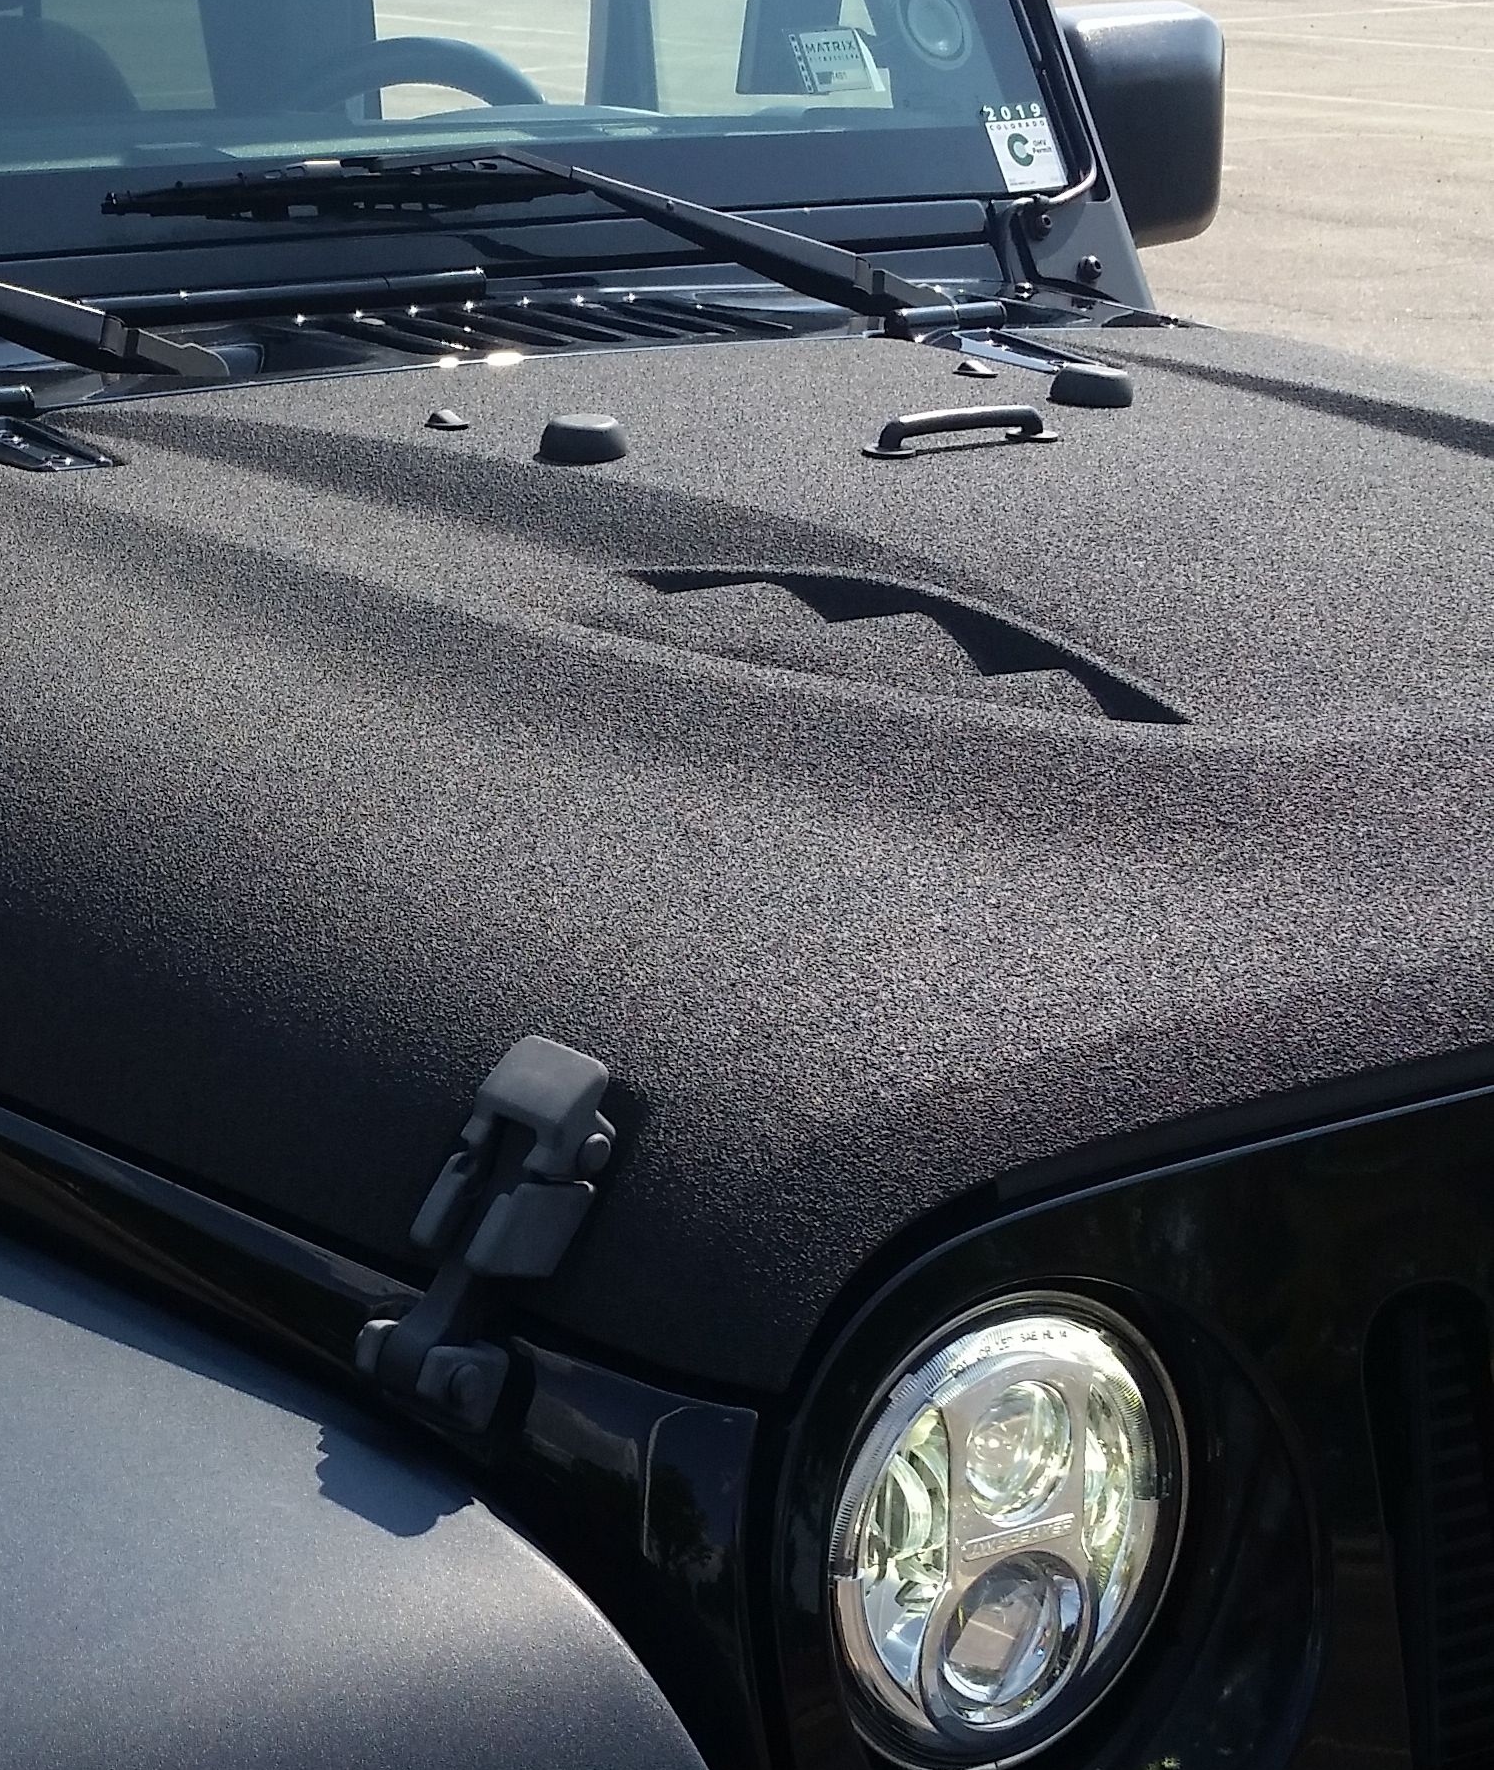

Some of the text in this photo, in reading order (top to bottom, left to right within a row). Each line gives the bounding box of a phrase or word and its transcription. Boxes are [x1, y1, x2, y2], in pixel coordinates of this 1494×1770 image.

[805, 40, 856, 54] MATRIX
[982, 102, 1042, 122] 2019
[989, 119, 1045, 131] COLORADO
[1020, 1330, 1038, 1343] SAE
